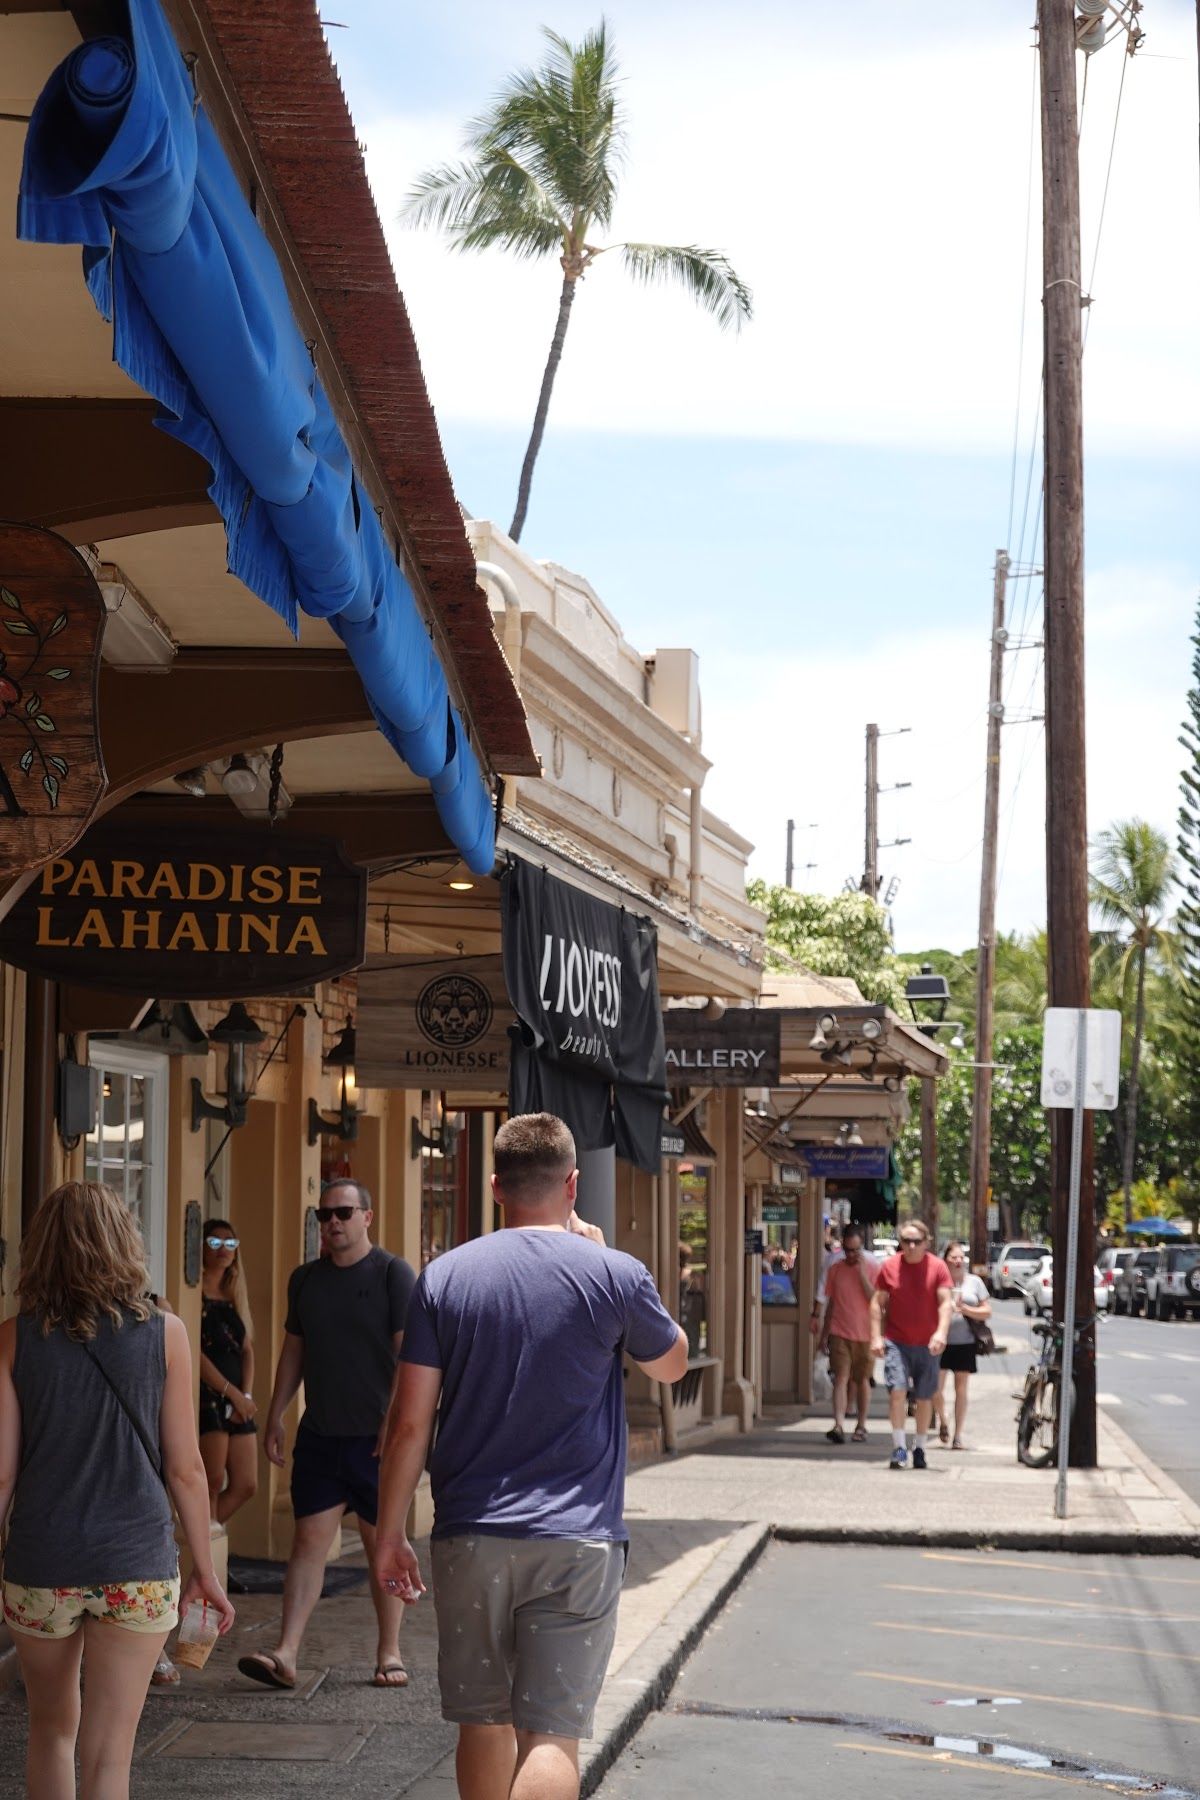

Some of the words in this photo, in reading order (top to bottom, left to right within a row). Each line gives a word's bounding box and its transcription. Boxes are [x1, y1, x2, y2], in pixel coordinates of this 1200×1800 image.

[40, 859, 322, 904] PARADISE
[36, 907, 328, 955] LAHAINA
[539, 934, 621, 1028] LIONESS
[406, 1050, 498, 1068] LIONESSE
[664, 1048, 767, 1068] ALLERY
